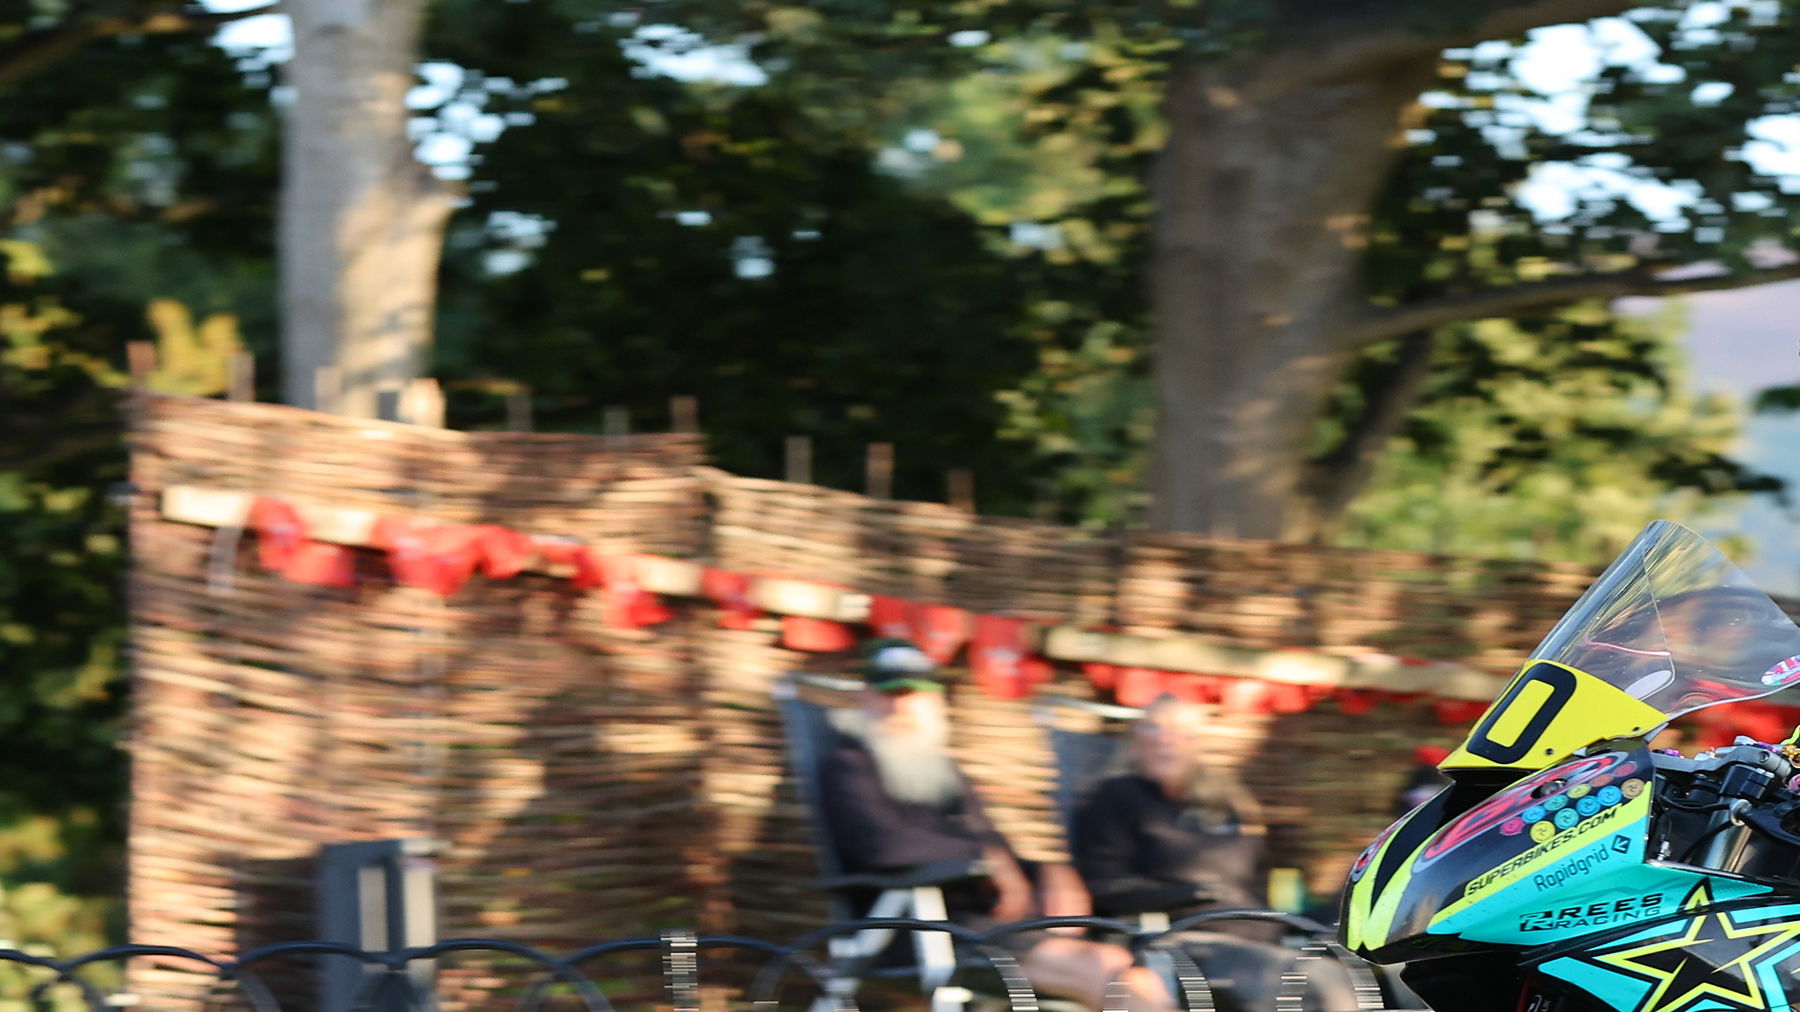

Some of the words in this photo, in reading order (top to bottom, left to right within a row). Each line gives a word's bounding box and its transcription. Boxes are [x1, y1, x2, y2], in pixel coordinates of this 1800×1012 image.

[1468, 809, 1617, 896] SUPERBIKES.COM
[1533, 845, 1610, 891] Rapidgrid
[1552, 906, 1661, 930] RACING
[1559, 893, 1664, 920] REES
